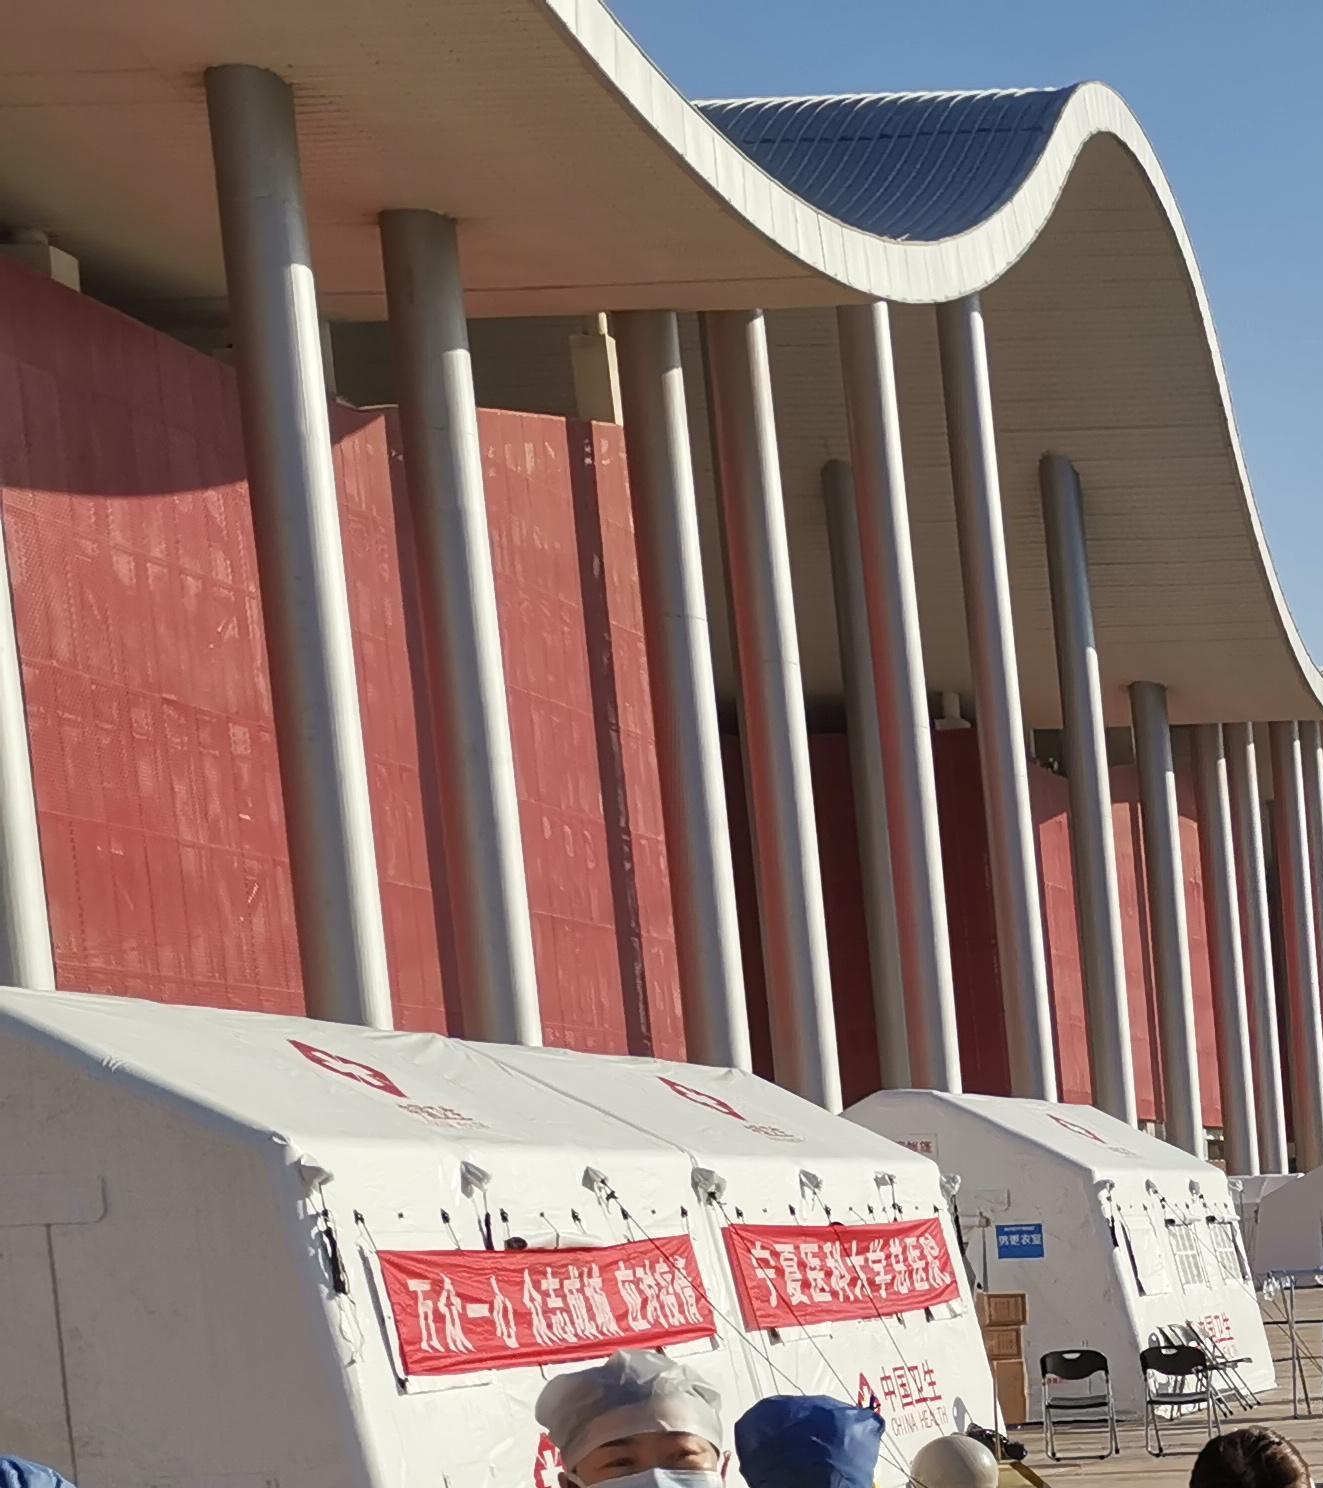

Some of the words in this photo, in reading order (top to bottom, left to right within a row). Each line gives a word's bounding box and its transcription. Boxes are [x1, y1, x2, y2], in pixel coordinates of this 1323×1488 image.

[521, 1263, 625, 1349] 众志成城
[615, 1254, 704, 1333] 应对疫情
[750, 1232, 951, 1308] 宁夏医科大学总医院
[880, 1359, 942, 1412] 中国卫生
[891, 1411, 918, 1438] CHINA
